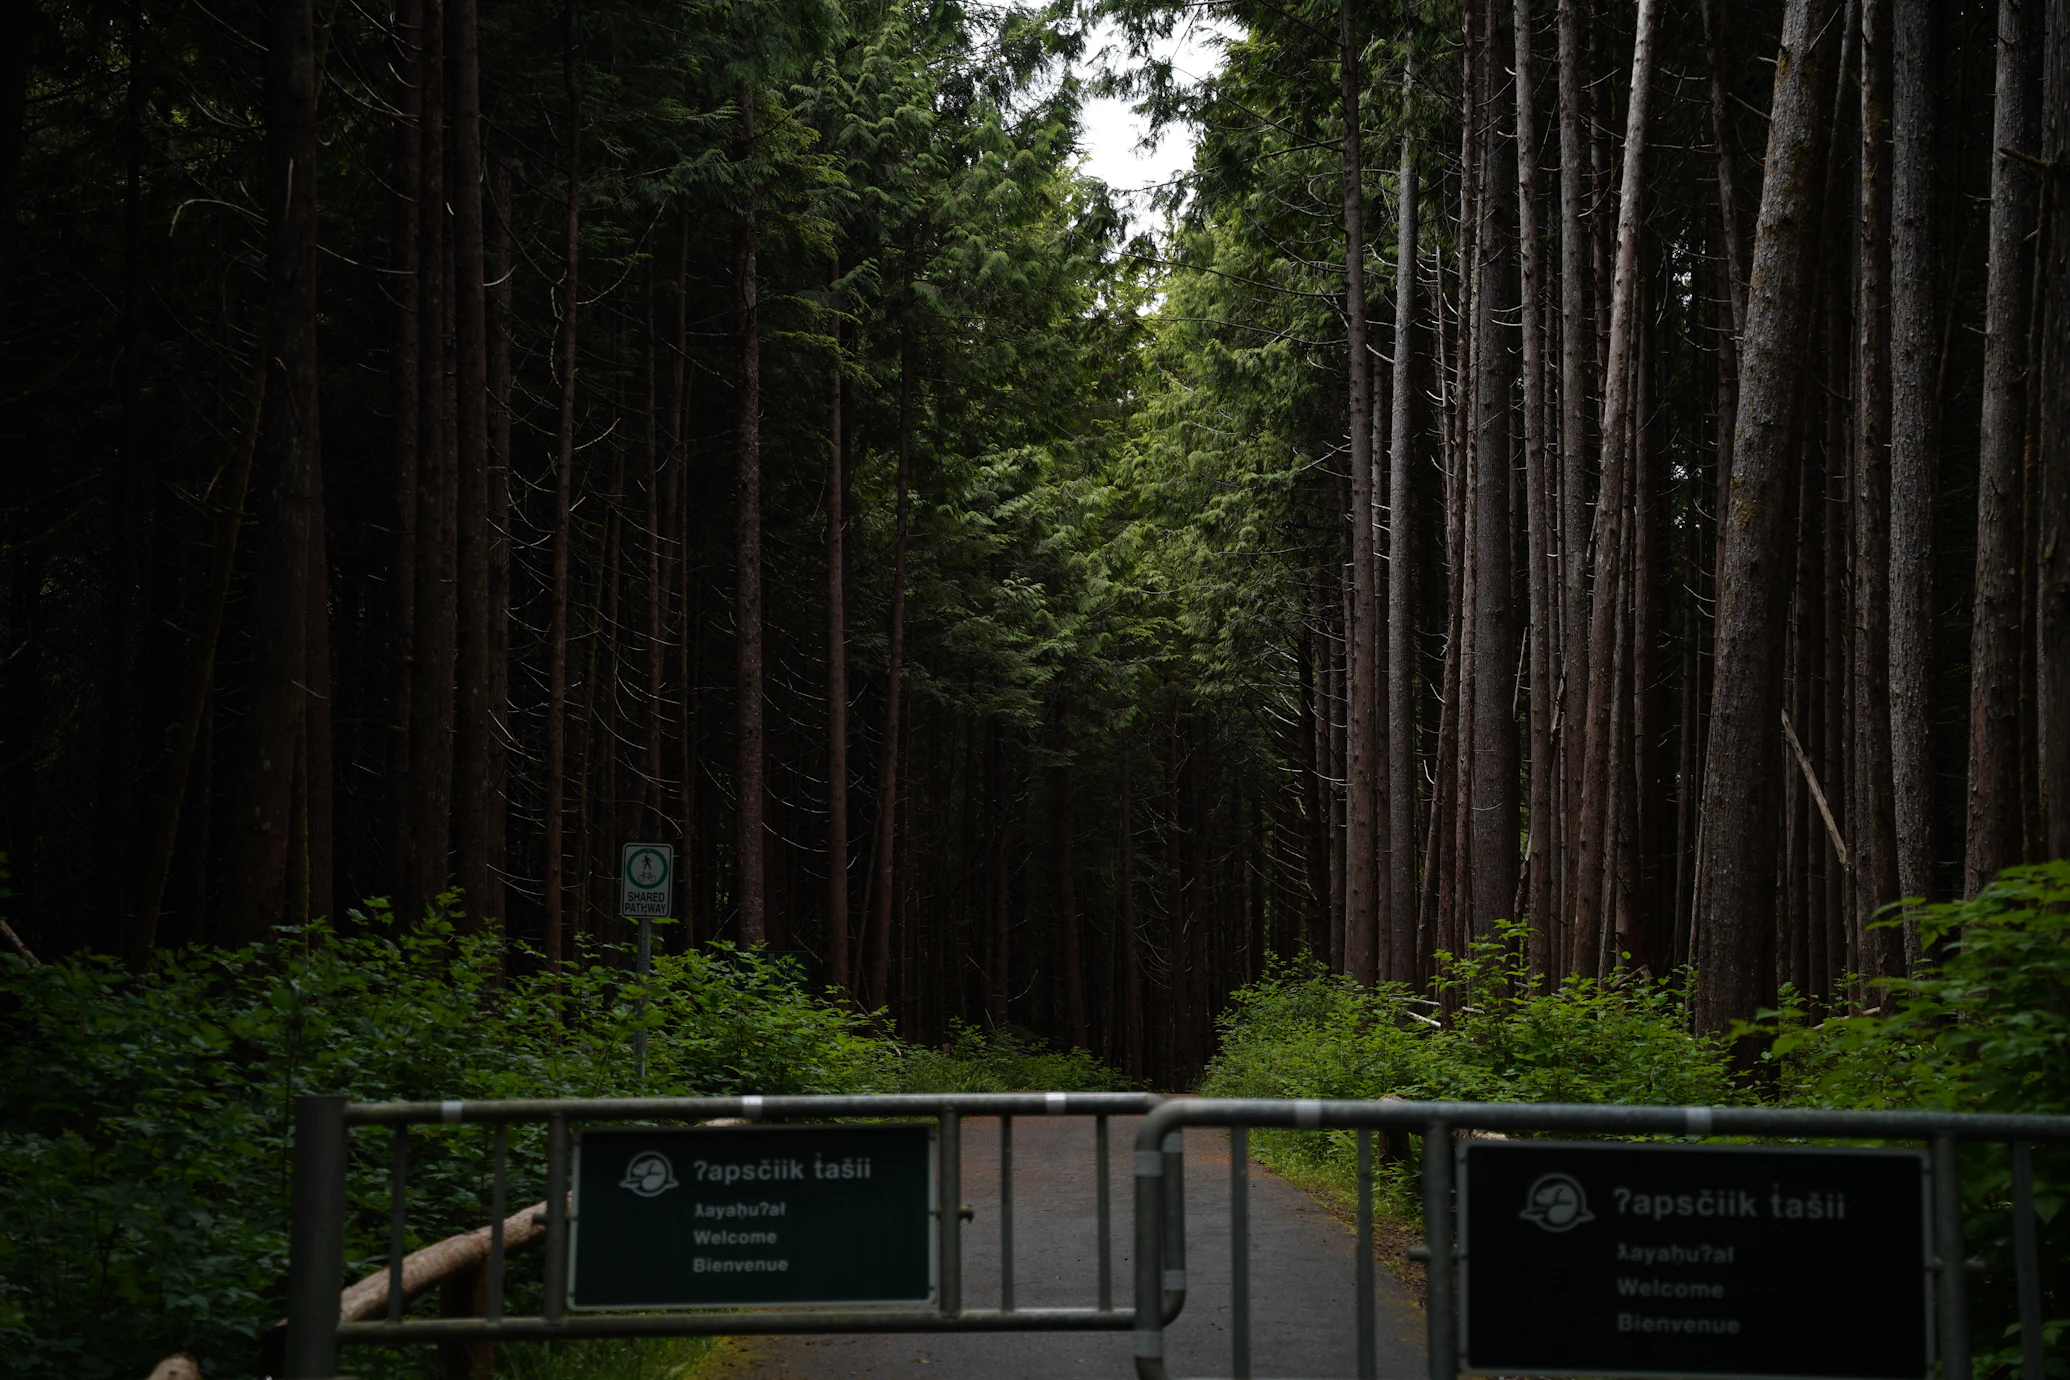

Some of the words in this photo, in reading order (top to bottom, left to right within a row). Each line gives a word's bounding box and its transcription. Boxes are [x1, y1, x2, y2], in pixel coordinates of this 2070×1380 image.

[627, 891, 665, 903] SHARED
[625, 902, 666, 913] PATHWAY
[693, 1230, 778, 1245] Welcome
[692, 1258, 789, 1273] Bienvenue
[1615, 1277, 1724, 1299] Welcome
[1617, 1312, 1741, 1335] Bienvenue
